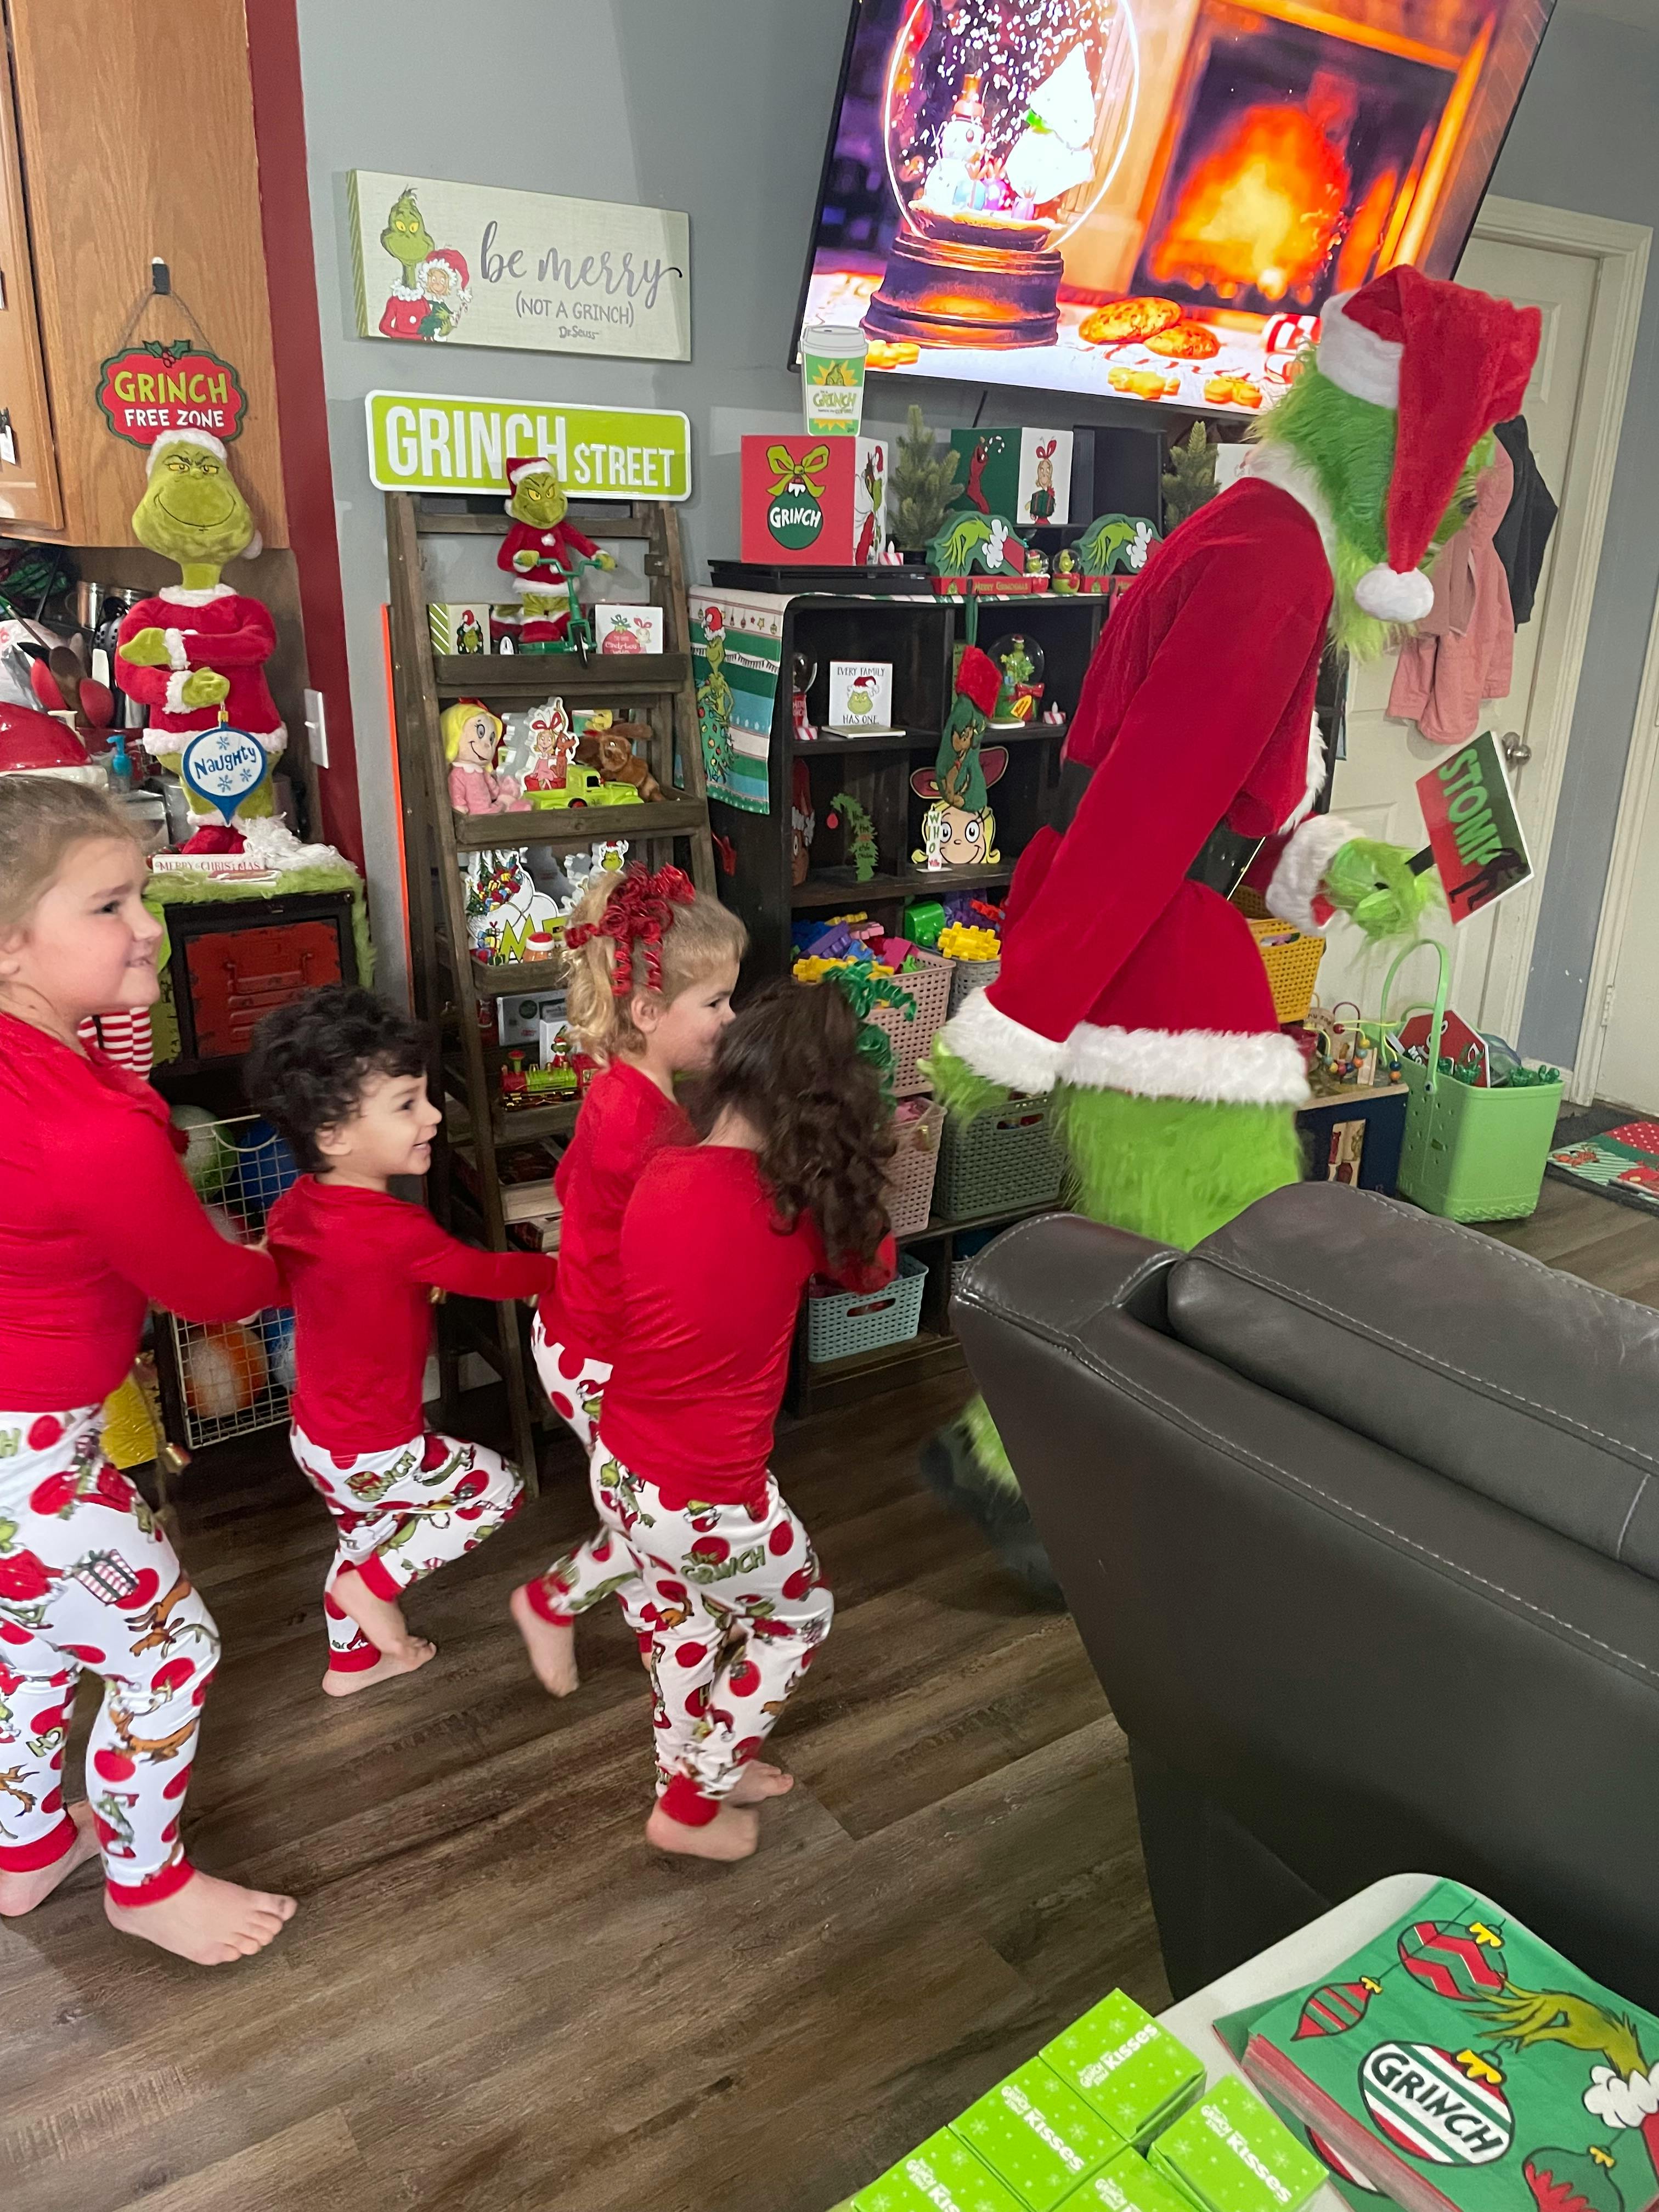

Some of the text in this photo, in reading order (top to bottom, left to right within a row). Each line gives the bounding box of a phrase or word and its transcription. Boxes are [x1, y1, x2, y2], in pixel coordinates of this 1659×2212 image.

[481, 221, 682, 309] be merry
[516, 290, 634, 328] (NOT A GRINCH)
[114, 370, 229, 405] GRINCH
[812, 391, 857, 409] GRINCH
[124, 409, 224, 428] FREE ZONE
[386, 405, 675, 487] GRINCH STREET
[770, 506, 822, 528] GRINCH
[837, 667, 885, 676] EVERY FAMILY
[843, 714, 860, 724] HAS
[1371, 2052, 1504, 2153] GRINCH
